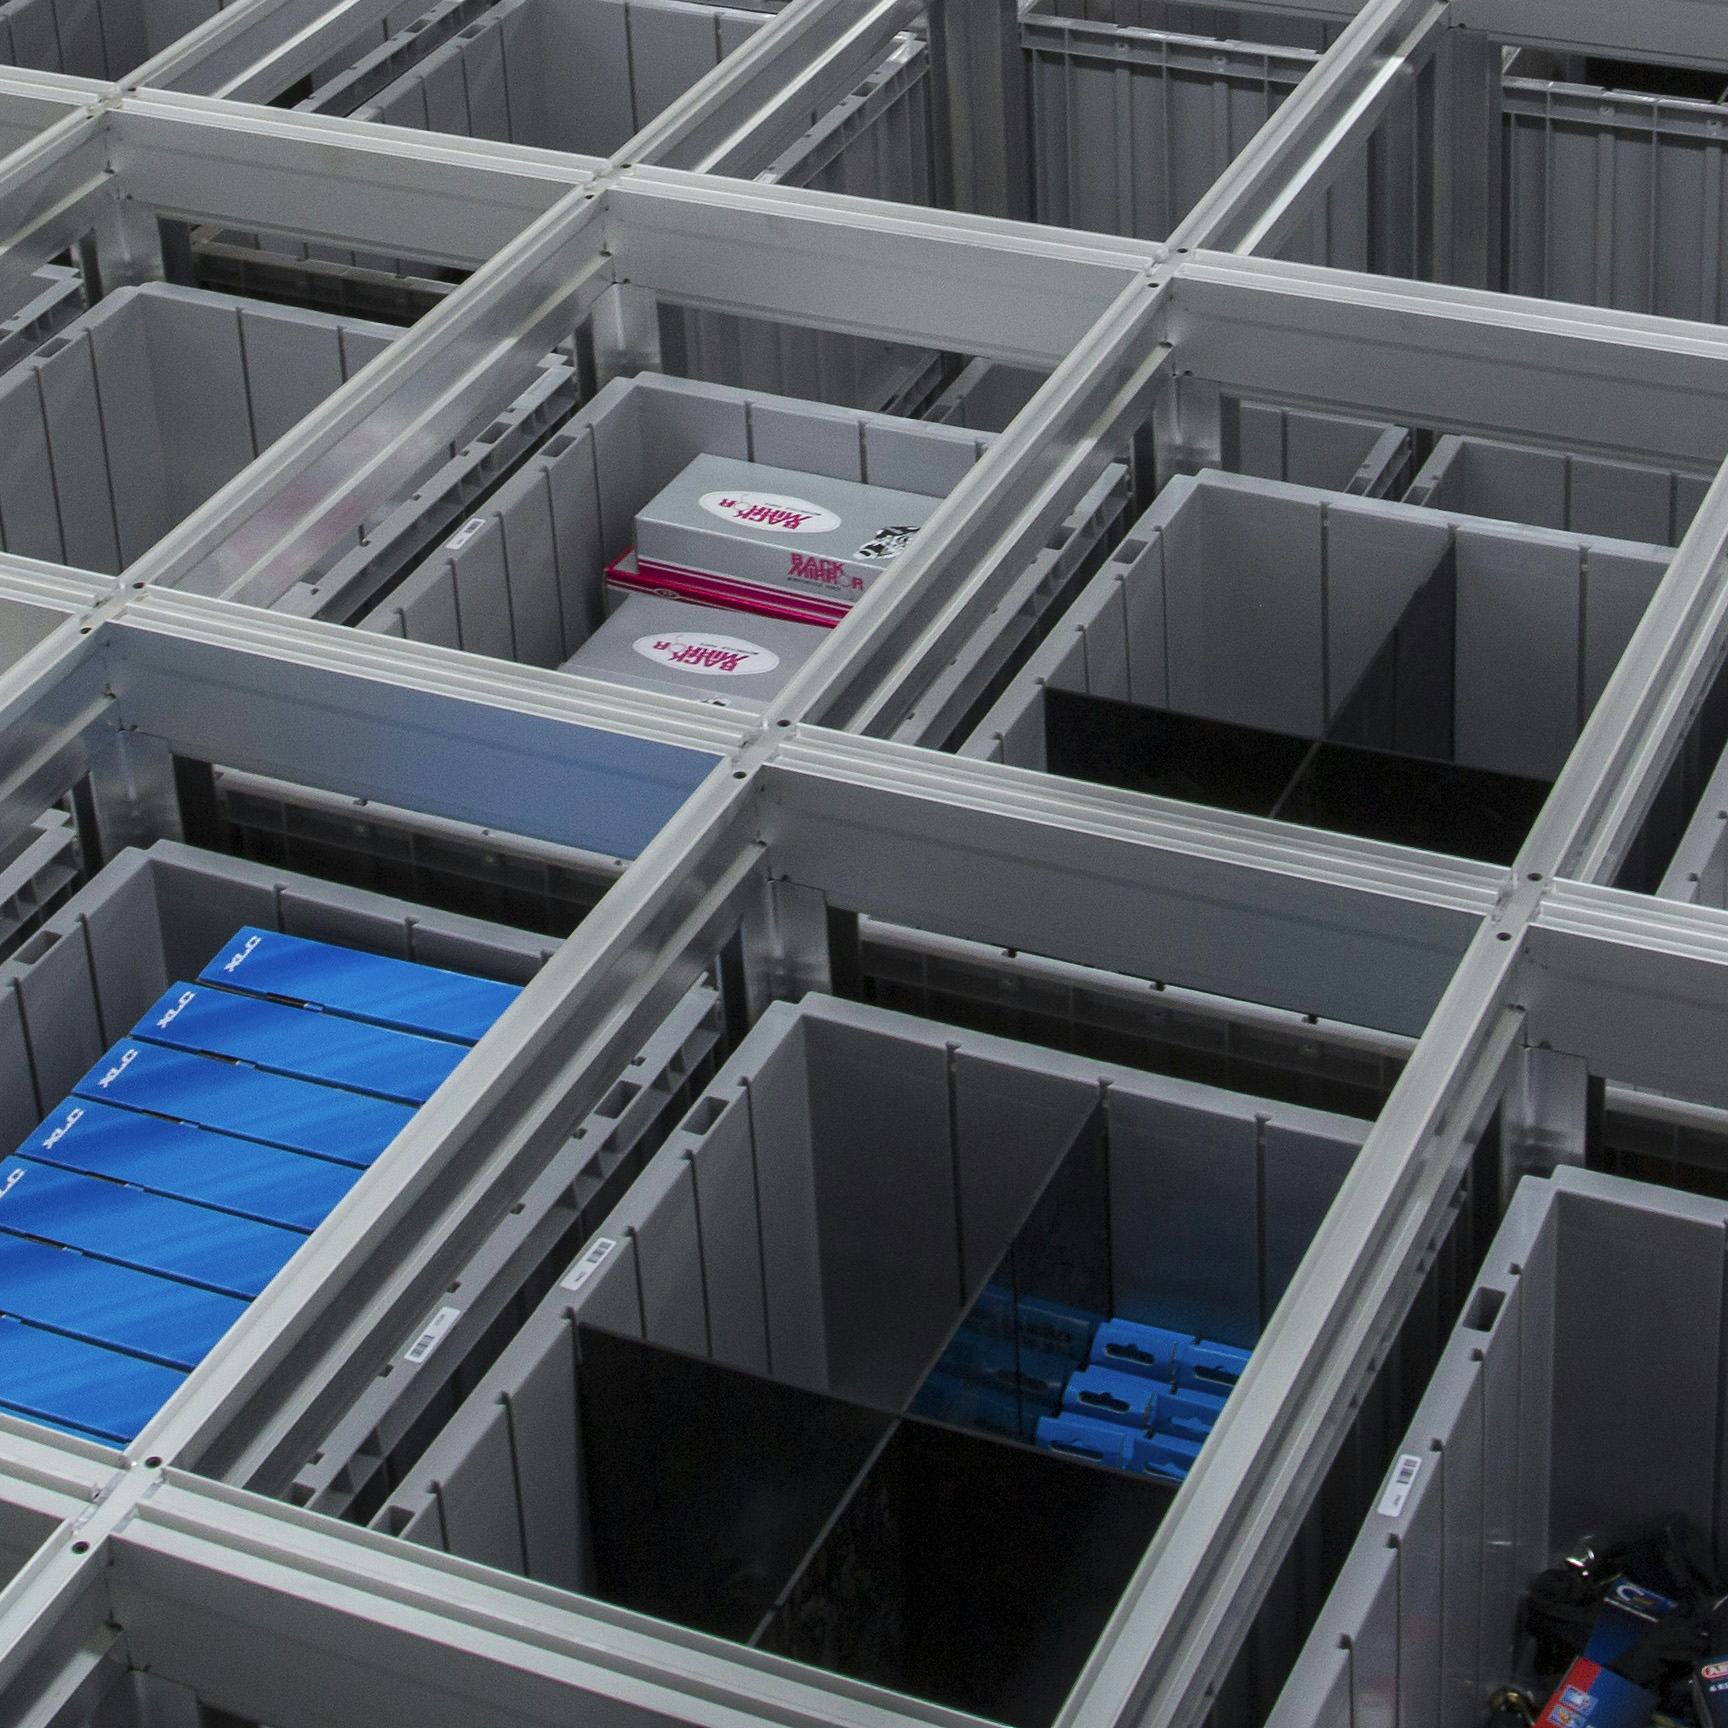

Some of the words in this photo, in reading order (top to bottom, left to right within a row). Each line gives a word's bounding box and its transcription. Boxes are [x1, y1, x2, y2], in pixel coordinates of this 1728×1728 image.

[223, 935, 263, 972] XLC
[156, 991, 197, 1028] XLC
[98, 1049, 139, 1088] XLC
[42, 1108, 85, 1150] XLC
